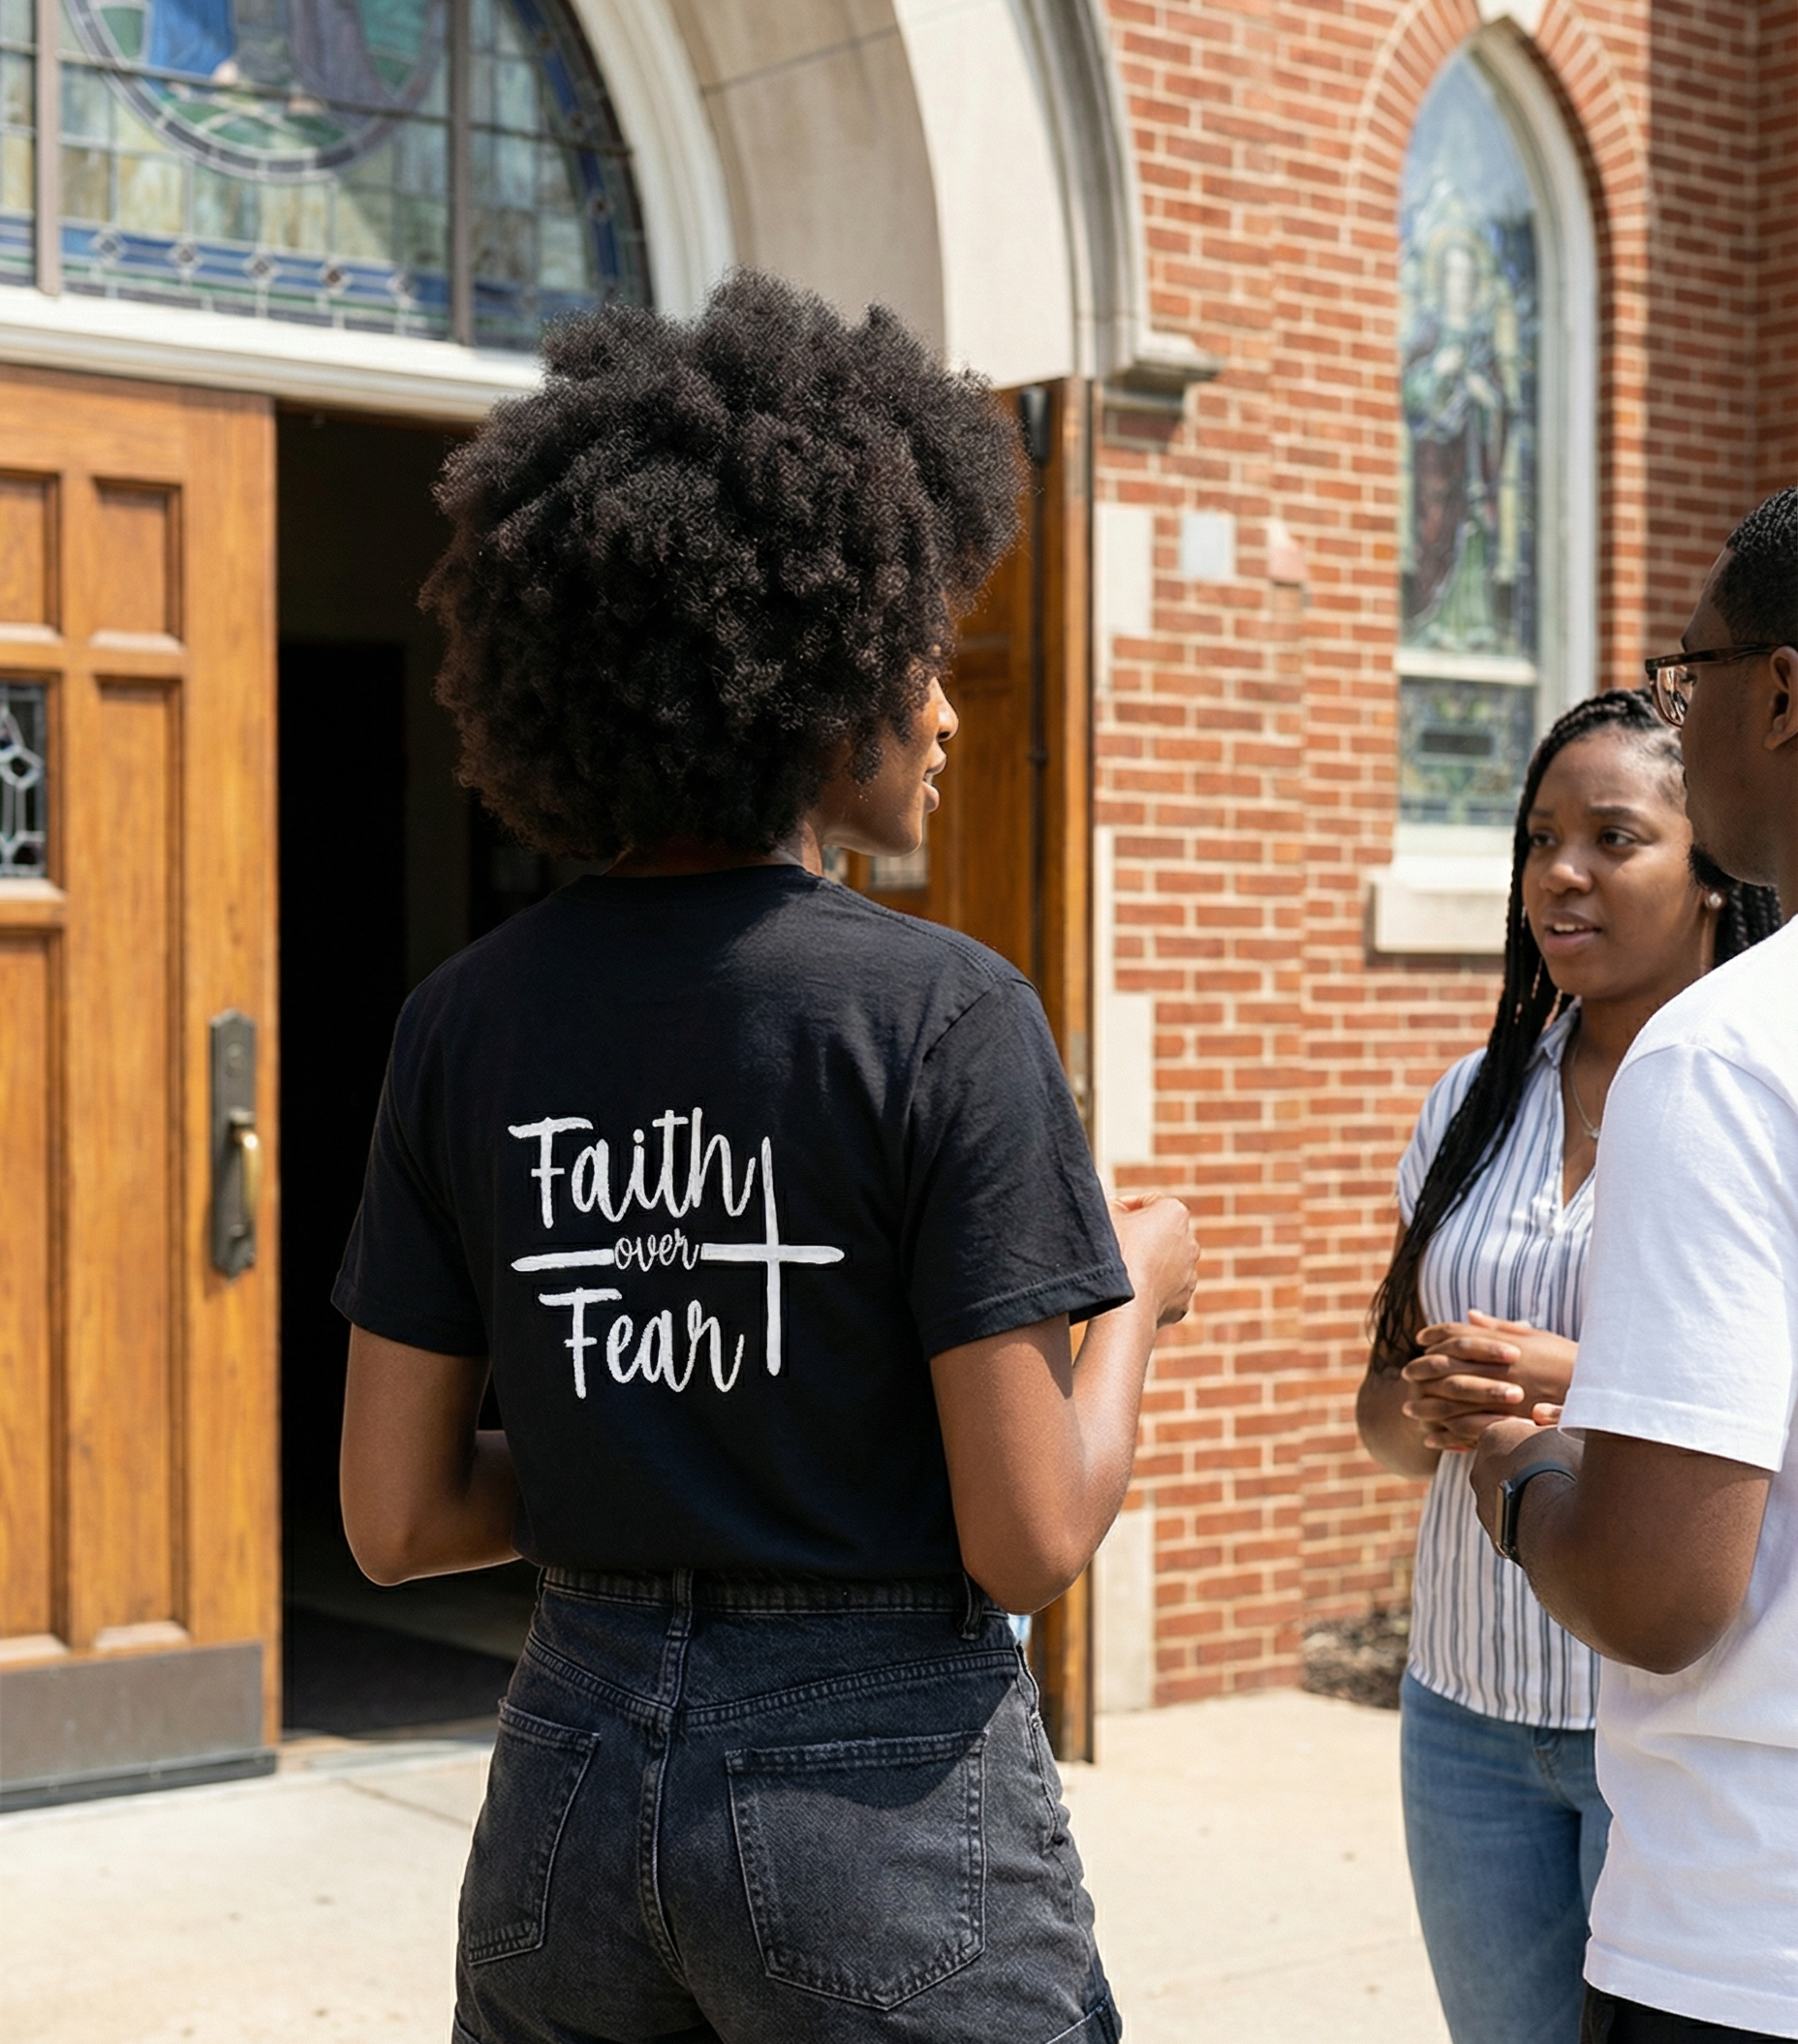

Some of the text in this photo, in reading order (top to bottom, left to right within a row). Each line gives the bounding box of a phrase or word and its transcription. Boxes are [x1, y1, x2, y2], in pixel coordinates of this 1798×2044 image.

[508, 1107, 757, 1229] Faith
[614, 1227, 699, 1272] over
[539, 1287, 745, 1400] Fear
